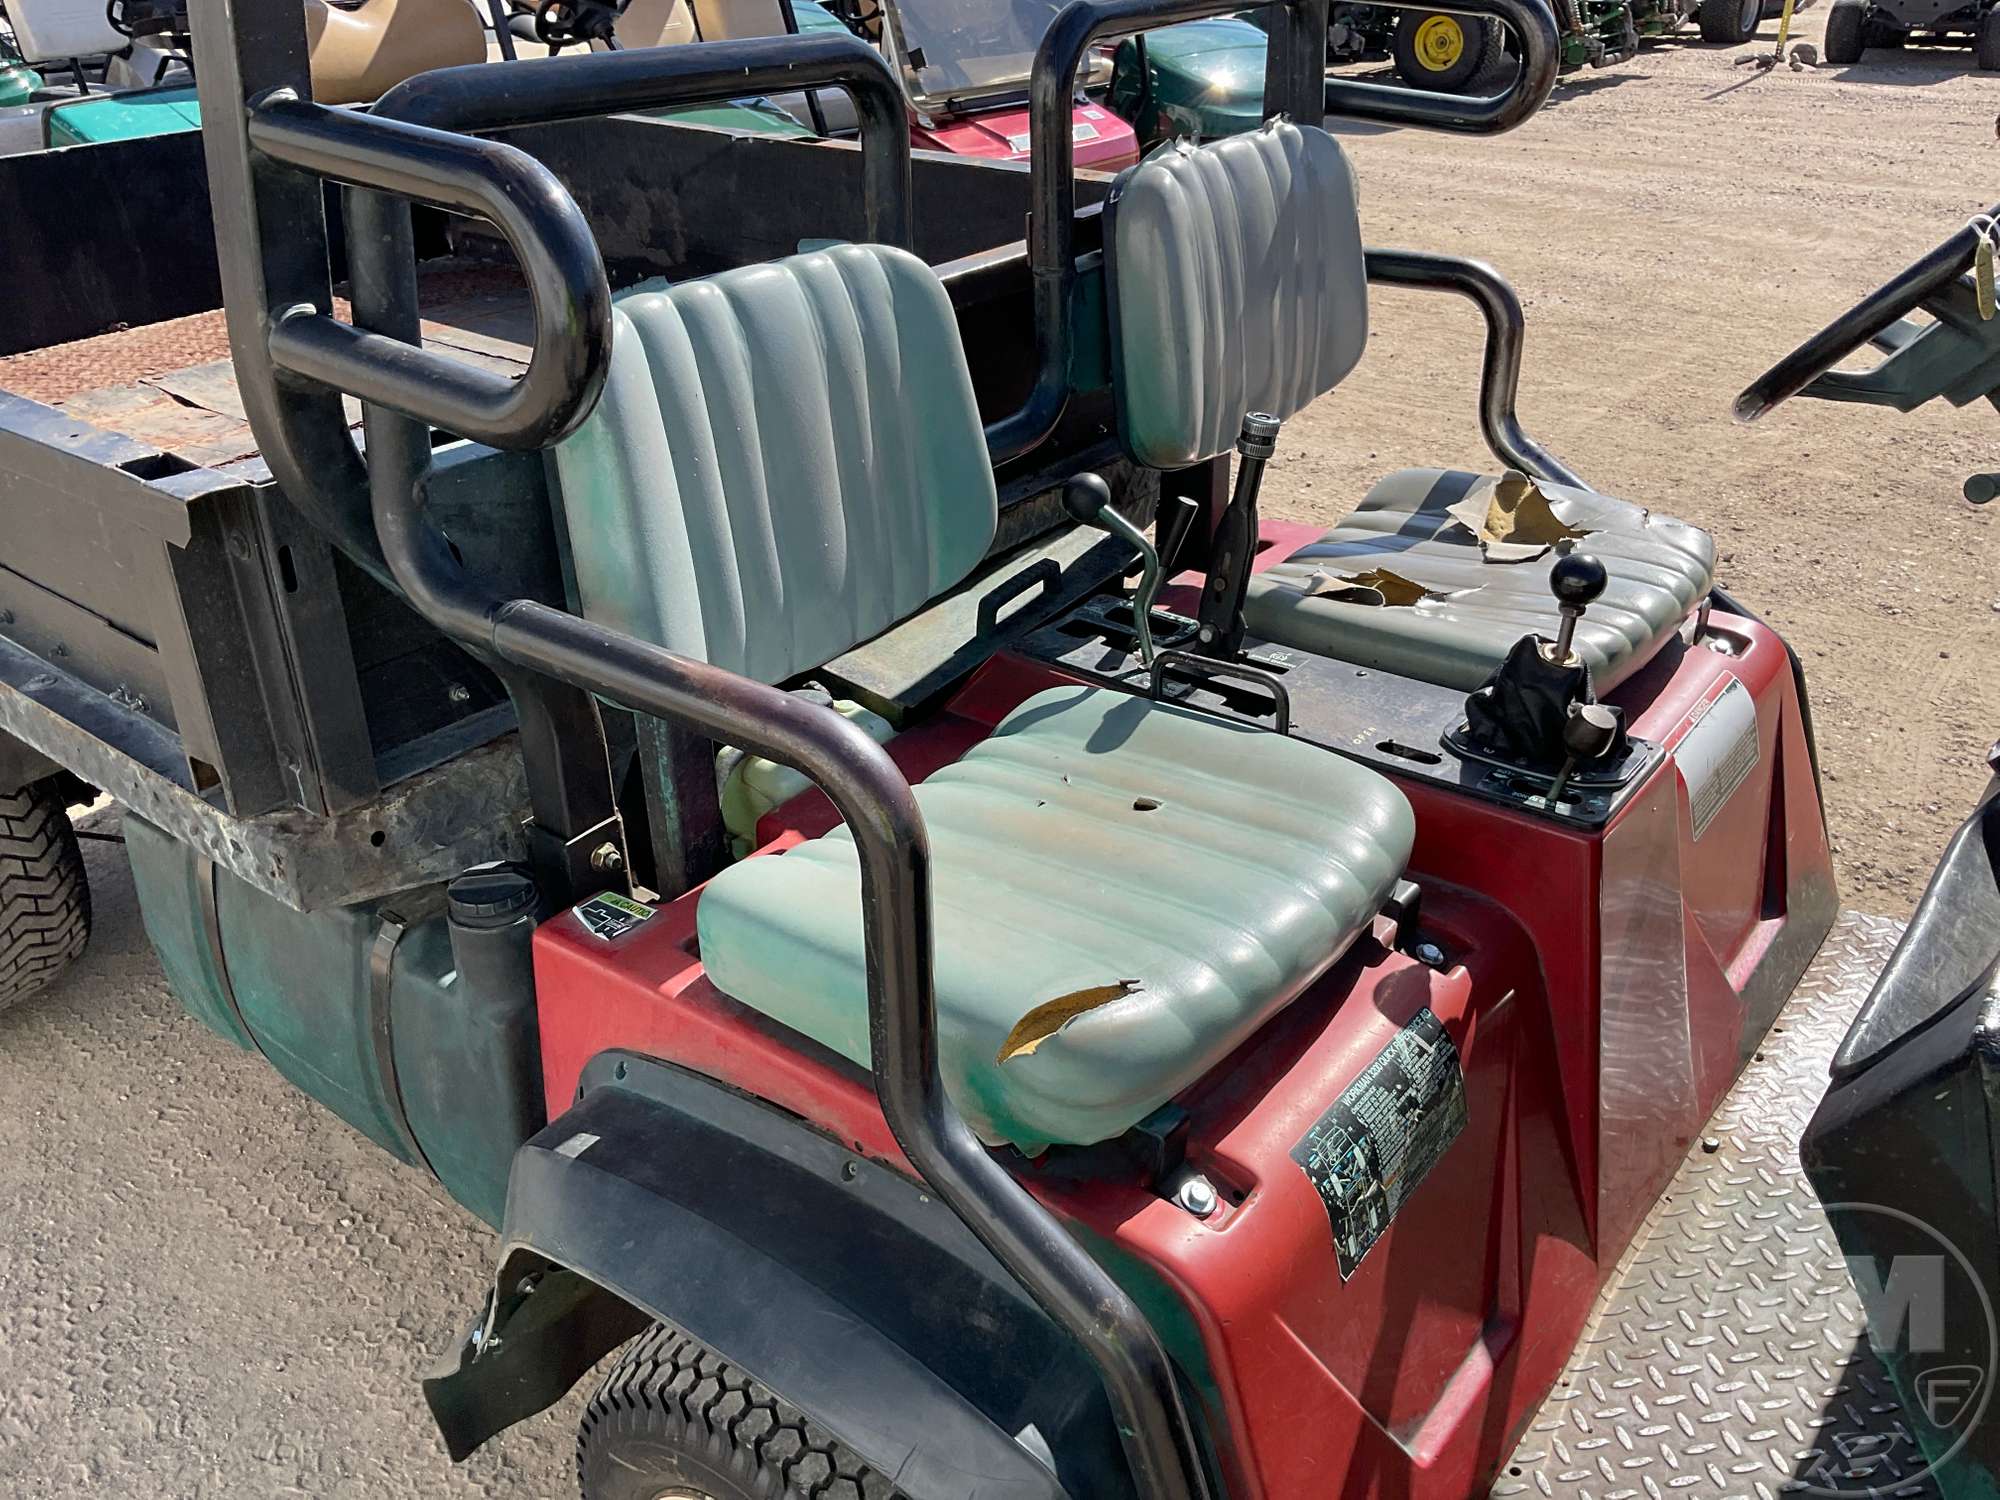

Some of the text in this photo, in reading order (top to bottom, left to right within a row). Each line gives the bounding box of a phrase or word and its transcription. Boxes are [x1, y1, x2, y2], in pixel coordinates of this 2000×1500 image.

[1341, 1073, 1373, 1107] WORKMAN
[1368, 1062, 1384, 1079] 3200
[1379, 1044, 1397, 1066] QUICK
[1419, 1007, 1432, 1021] AID
